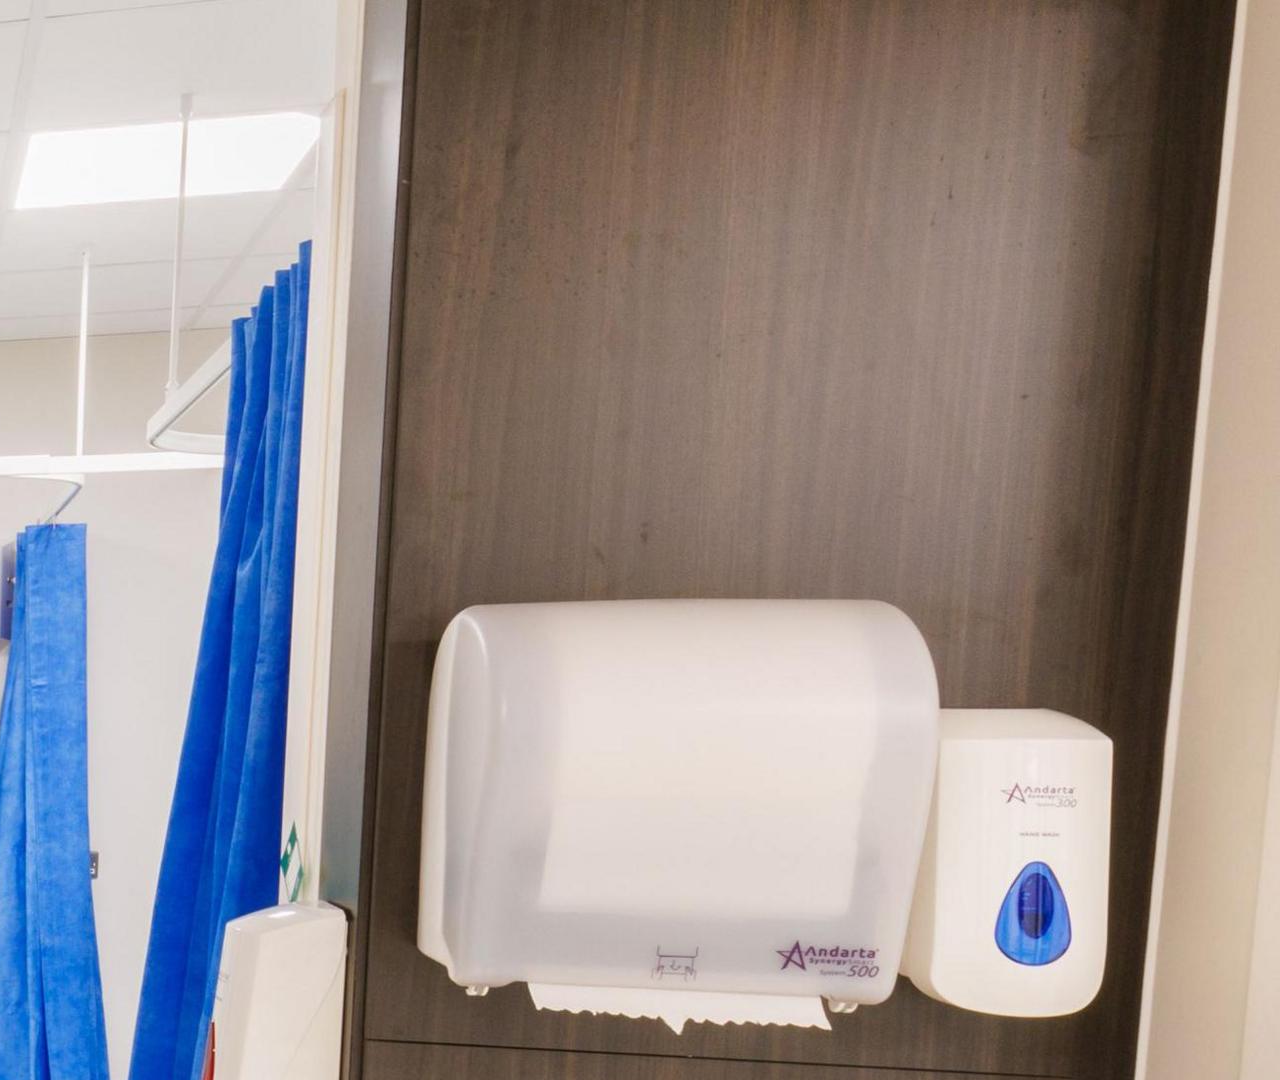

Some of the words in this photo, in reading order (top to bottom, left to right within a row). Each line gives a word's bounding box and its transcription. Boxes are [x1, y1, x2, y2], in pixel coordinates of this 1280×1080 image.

[1023, 785, 1074, 794] Andarta
[1055, 798, 1077, 808] 300
[805, 946, 876, 958] Andarta
[847, 965, 880, 978] 500
